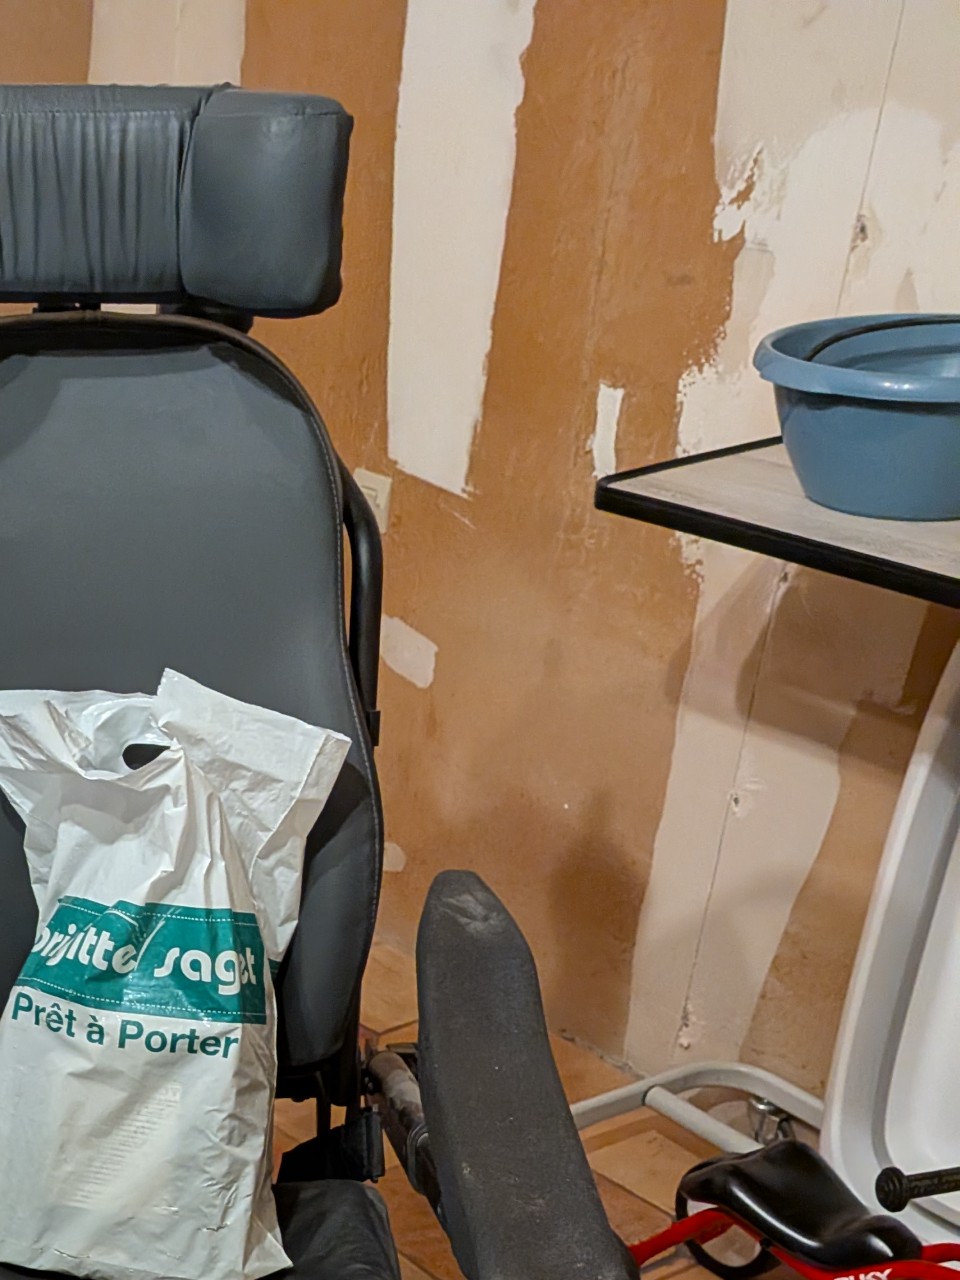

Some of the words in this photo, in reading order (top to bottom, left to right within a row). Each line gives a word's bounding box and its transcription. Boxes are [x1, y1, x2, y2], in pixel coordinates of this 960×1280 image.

[11, 991, 76, 1038] Prêt
[86, 1014, 105, 1045] à
[117, 1019, 239, 1059] Porter
